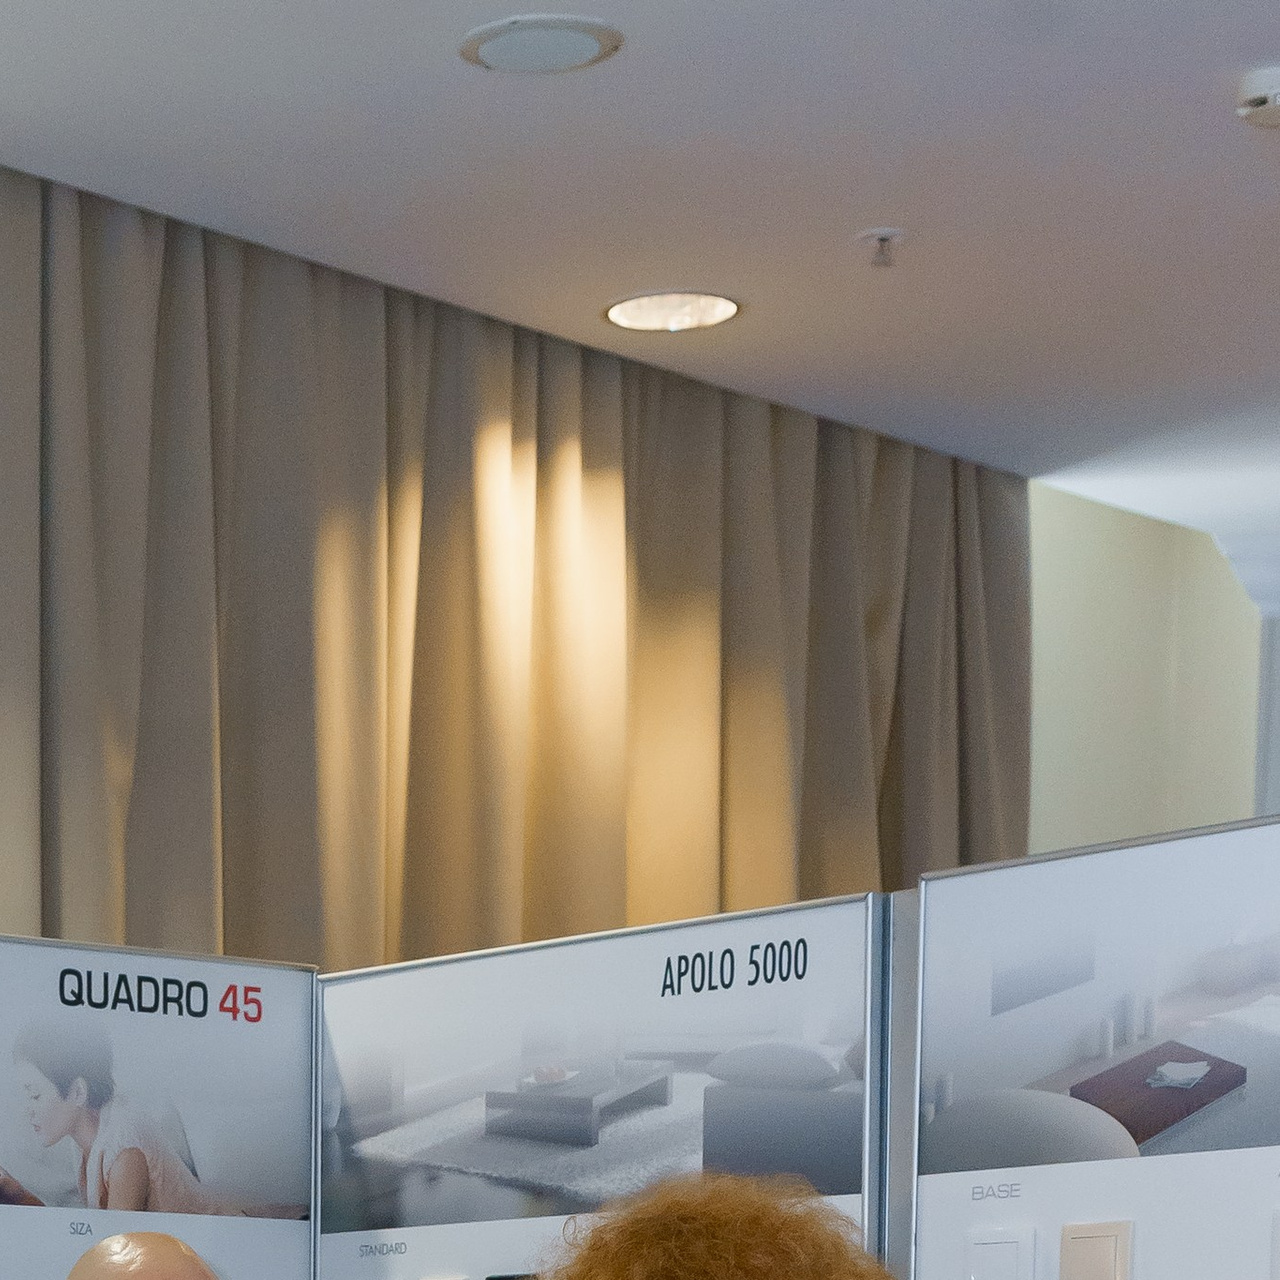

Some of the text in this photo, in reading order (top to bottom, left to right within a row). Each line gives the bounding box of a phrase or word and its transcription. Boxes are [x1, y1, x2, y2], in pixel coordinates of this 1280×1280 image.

[660, 938, 809, 998] APOLO 5000
[58, 968, 263, 1023] QUADRO 45
[971, 1183, 1022, 1201] BASE
[69, 1222, 93, 1236] SIZA
[358, 1242, 407, 1256] STANDARD
